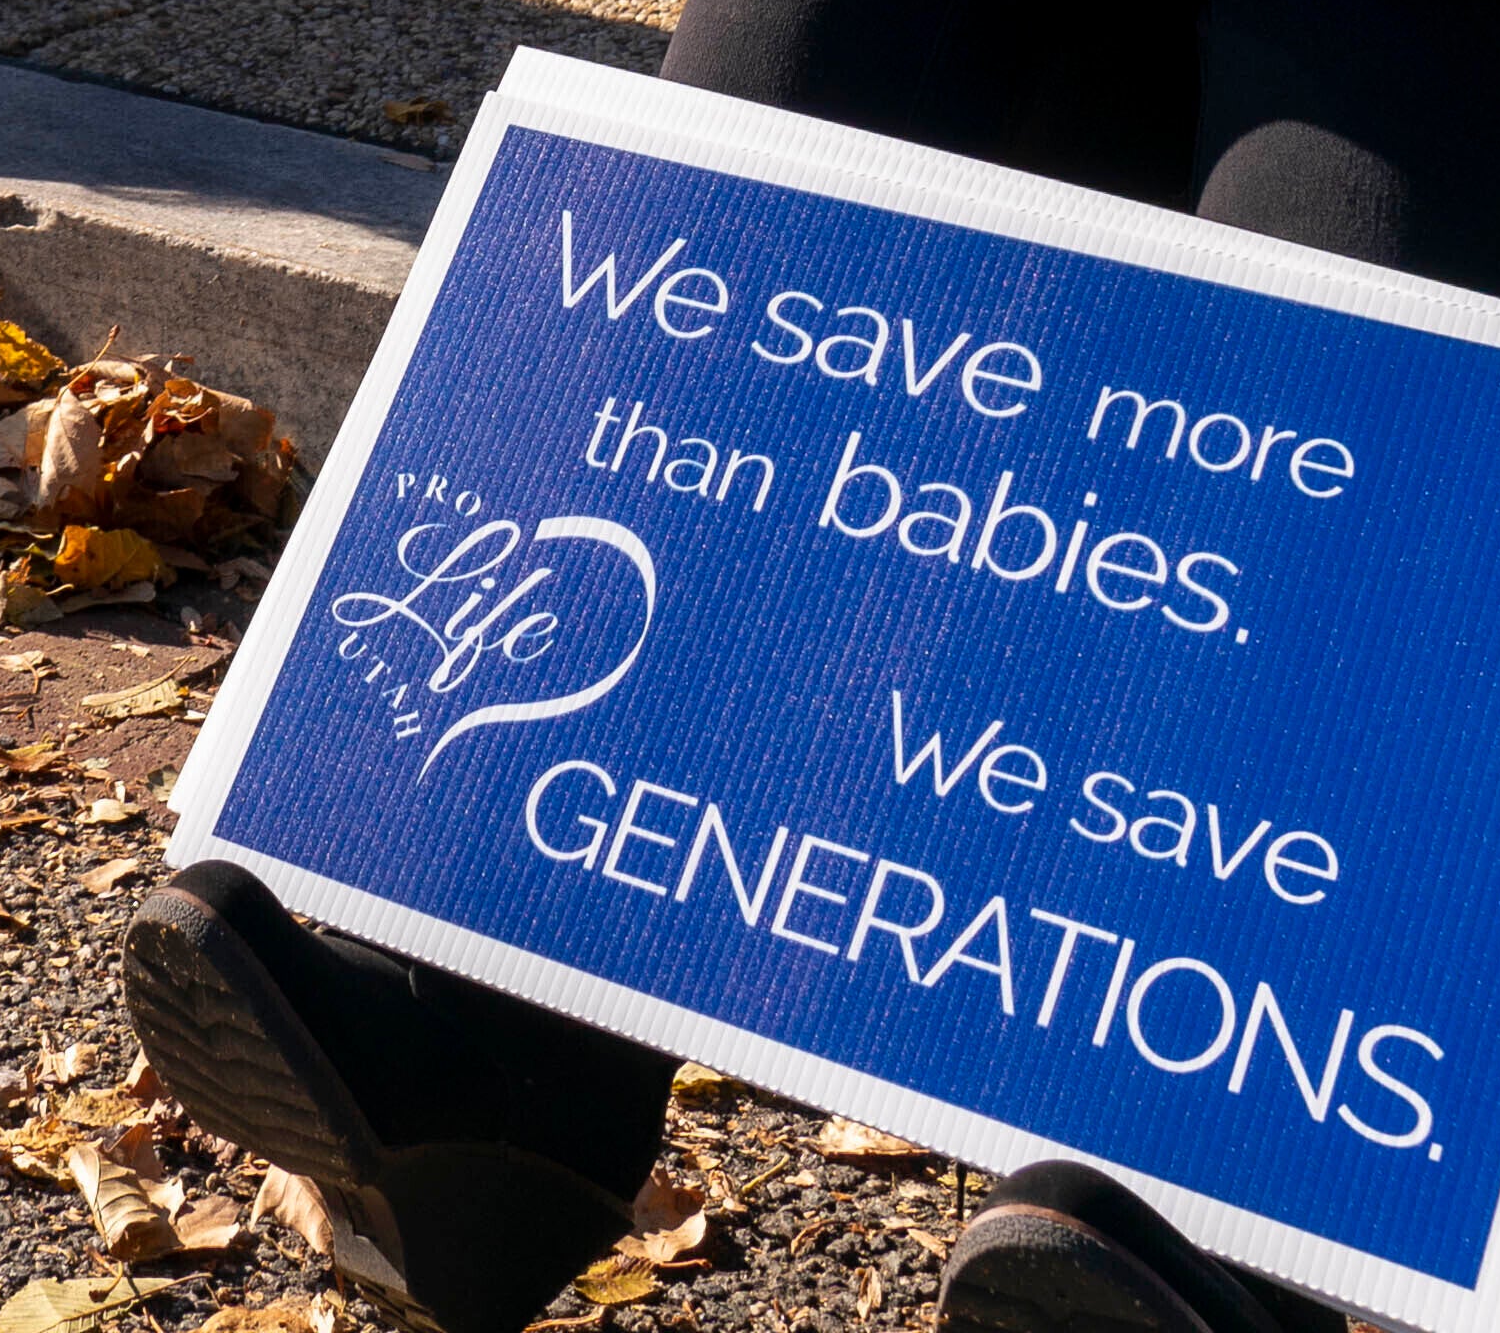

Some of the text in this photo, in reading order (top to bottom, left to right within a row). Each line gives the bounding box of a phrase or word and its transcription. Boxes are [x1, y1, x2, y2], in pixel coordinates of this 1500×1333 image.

[558, 205, 1357, 501] We save more
[396, 472, 482, 518] PRO
[584, 393, 1251, 643] than babies.
[331, 519, 560, 694] Life
[337, 630, 422, 741] UTAH
[890, 686, 1341, 906] We save
[524, 757, 1448, 1162] GENERATIONS.
